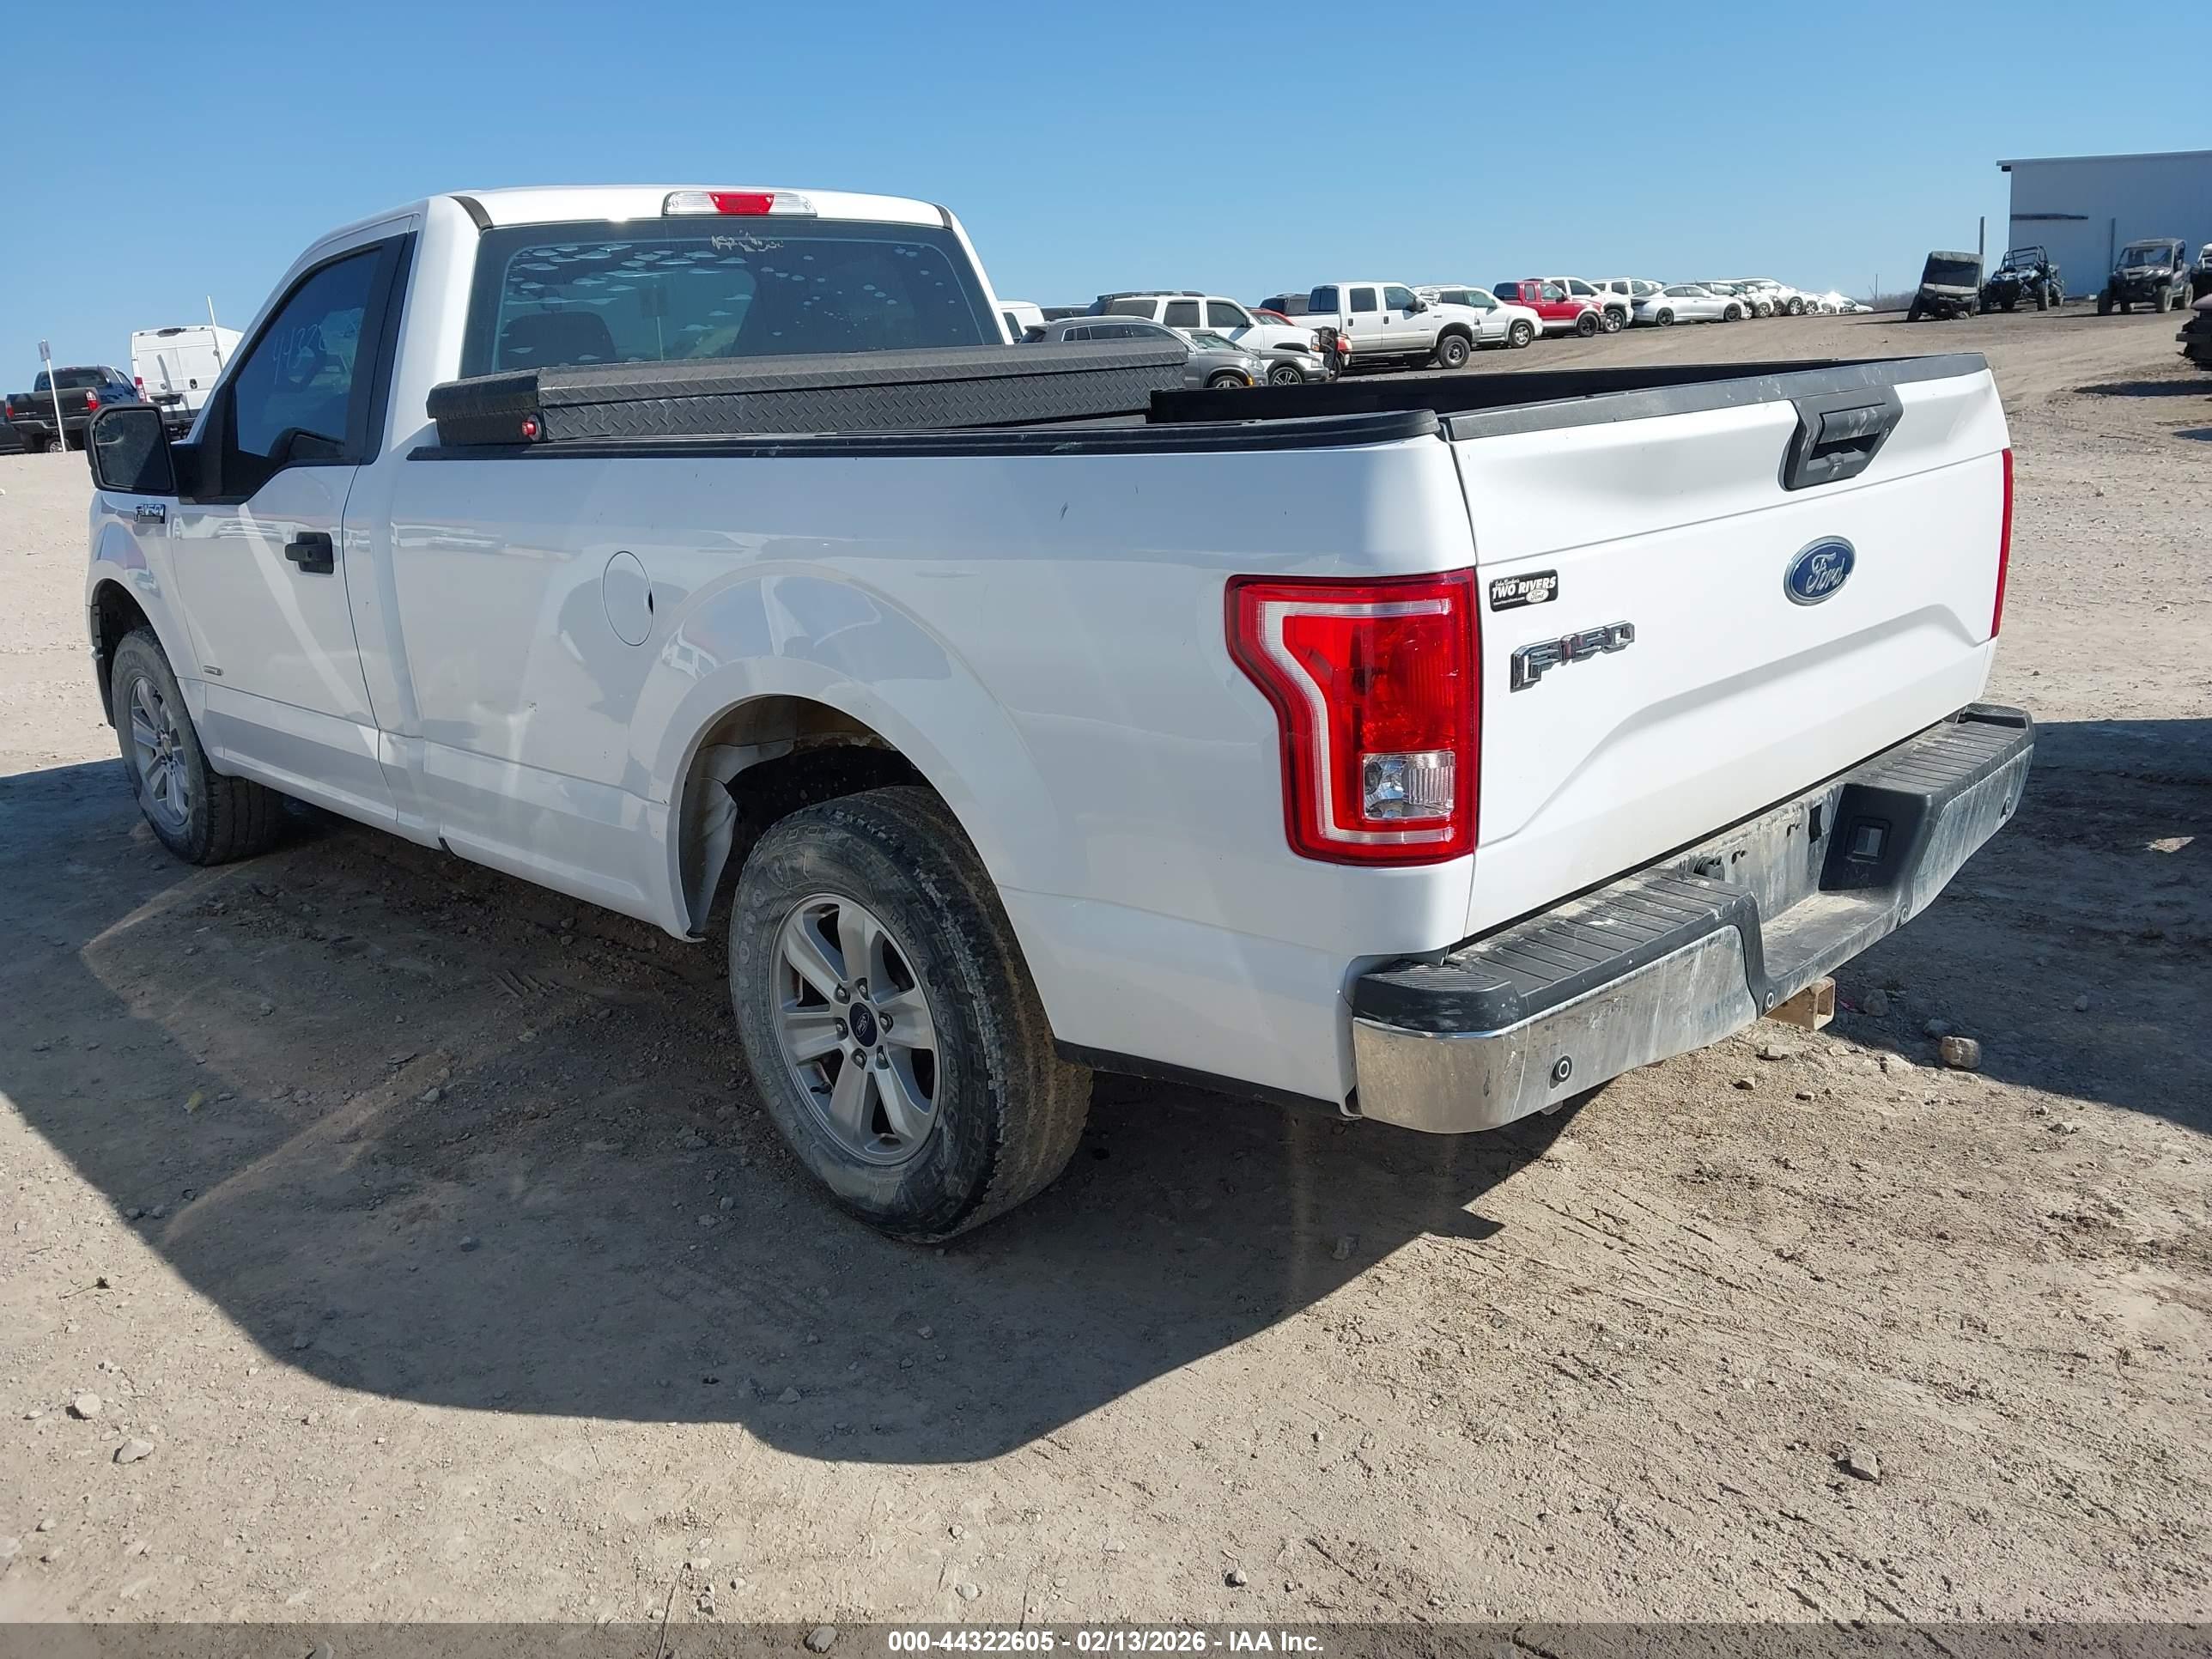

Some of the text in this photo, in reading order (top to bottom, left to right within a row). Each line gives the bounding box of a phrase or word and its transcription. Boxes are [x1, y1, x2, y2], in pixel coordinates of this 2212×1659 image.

[1492, 584, 1516, 599] TWO
[1518, 576, 1557, 594] RIVERS
[1806, 552, 1845, 593] Ford
